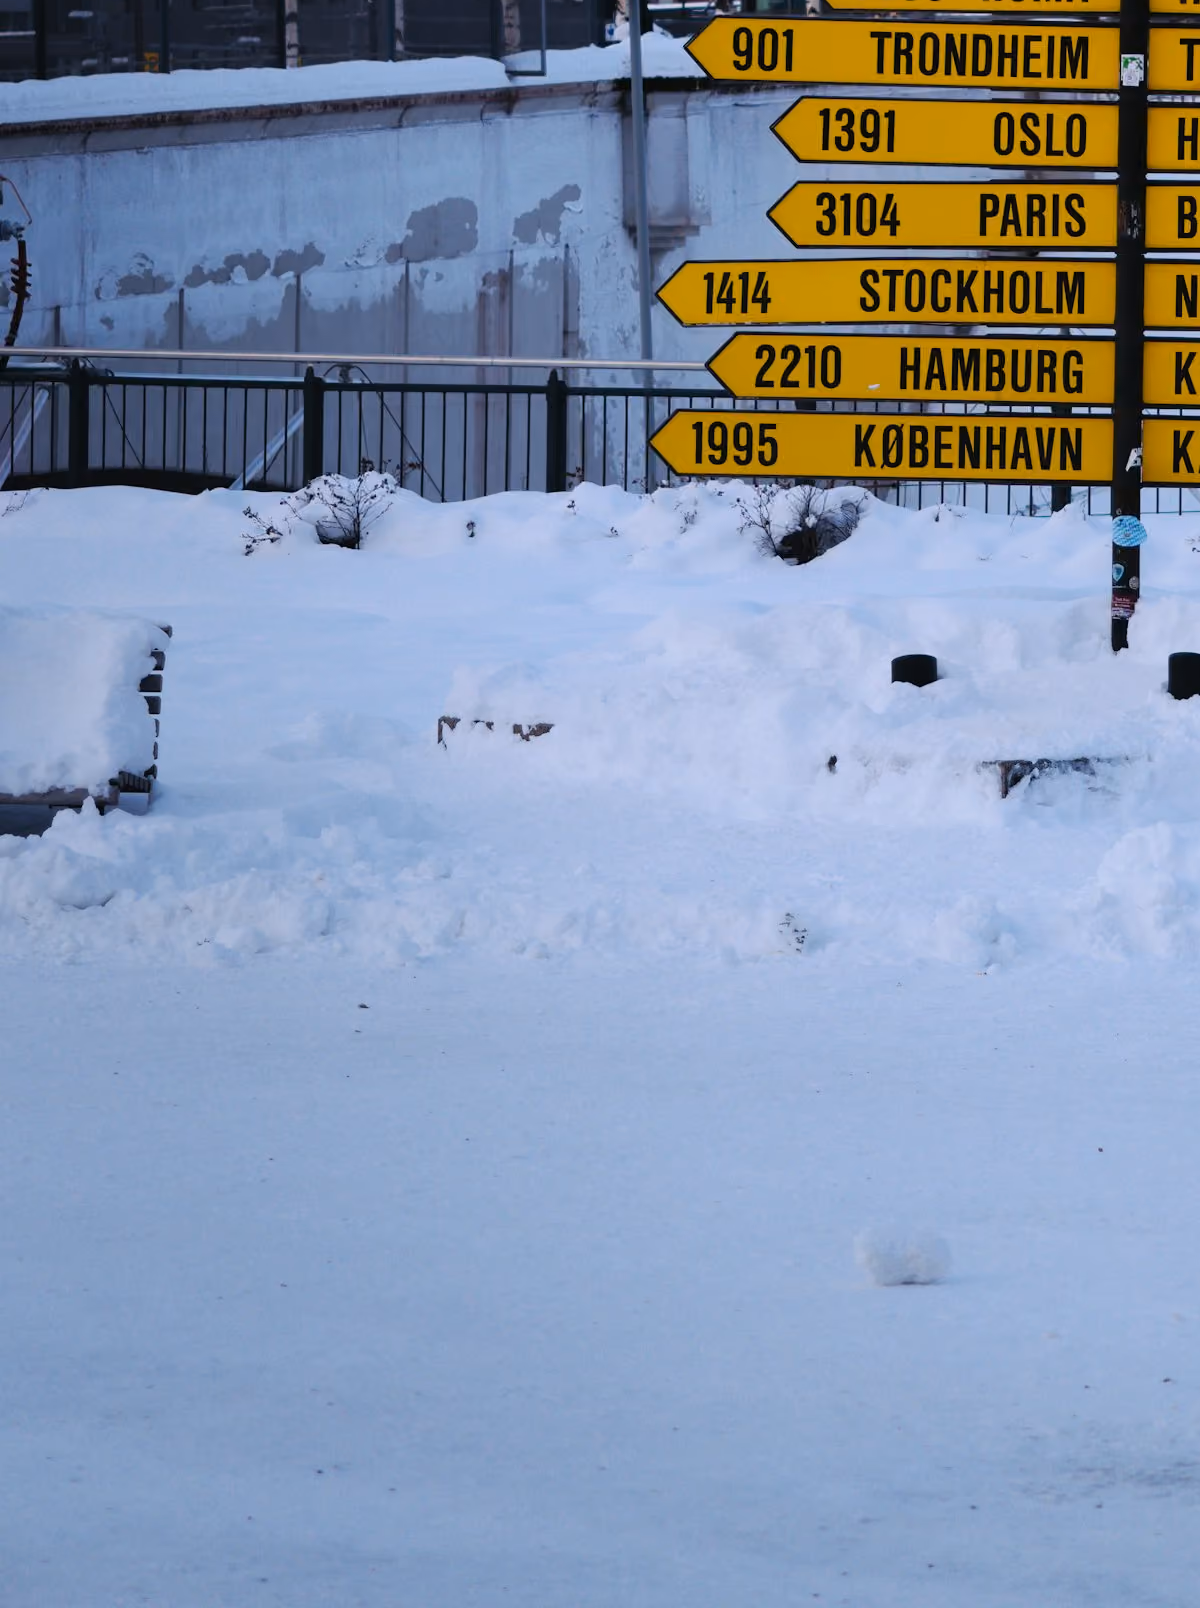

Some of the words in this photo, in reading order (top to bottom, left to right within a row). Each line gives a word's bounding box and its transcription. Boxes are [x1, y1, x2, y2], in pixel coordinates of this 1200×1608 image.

[733, 27, 793, 71] 901
[870, 31, 1088, 79] TRONDHEIM
[820, 108, 895, 152] 1391
[994, 112, 1086, 157] OSLO
[816, 193, 900, 236] 3104
[980, 194, 1085, 237] PARIS
[704, 272, 771, 313] 1414
[860, 269, 1084, 314] STOCKHOLM
[755, 345, 841, 388] 2210
[900, 347, 1083, 393] HAMBURG
[692, 422, 777, 466] 1995
[855, 424, 1082, 470] KØBENHAVN
